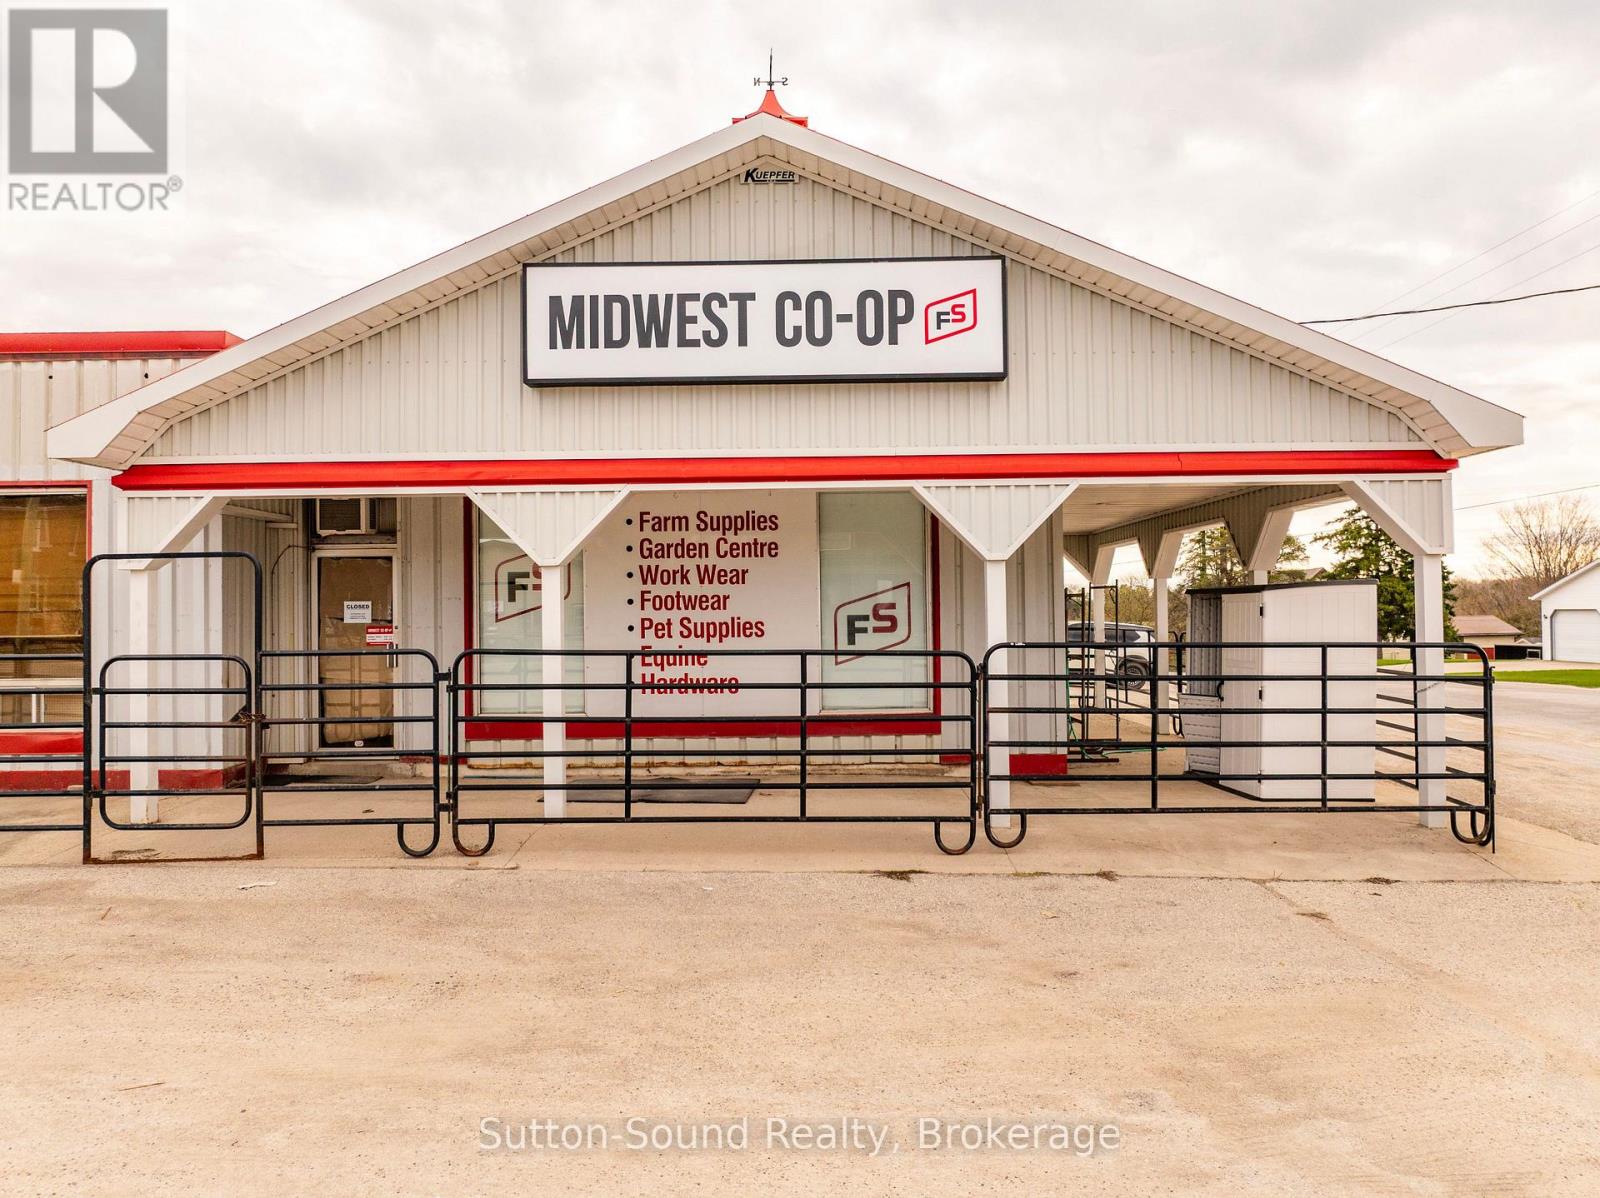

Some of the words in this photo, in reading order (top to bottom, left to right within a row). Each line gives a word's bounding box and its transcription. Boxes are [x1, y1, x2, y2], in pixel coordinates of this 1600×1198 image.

[744, 167, 796, 182] KUEPFER
[548, 292, 756, 350] MIDWEST
[775, 289, 915, 347] CO-OP
[936, 303, 967, 331] FS
[639, 511, 690, 532] Farm
[695, 510, 779, 536] Supplies
[639, 537, 709, 560] Garden
[715, 536, 779, 558] Centre
[639, 564, 691, 586] Work
[696, 564, 749, 585] Wear
[640, 590, 730, 611] Footwear
[640, 618, 673, 639] Pet
[679, 616, 765, 643] Supplies
[847, 602, 898, 646] FS
[640, 645, 708, 671] Equine
